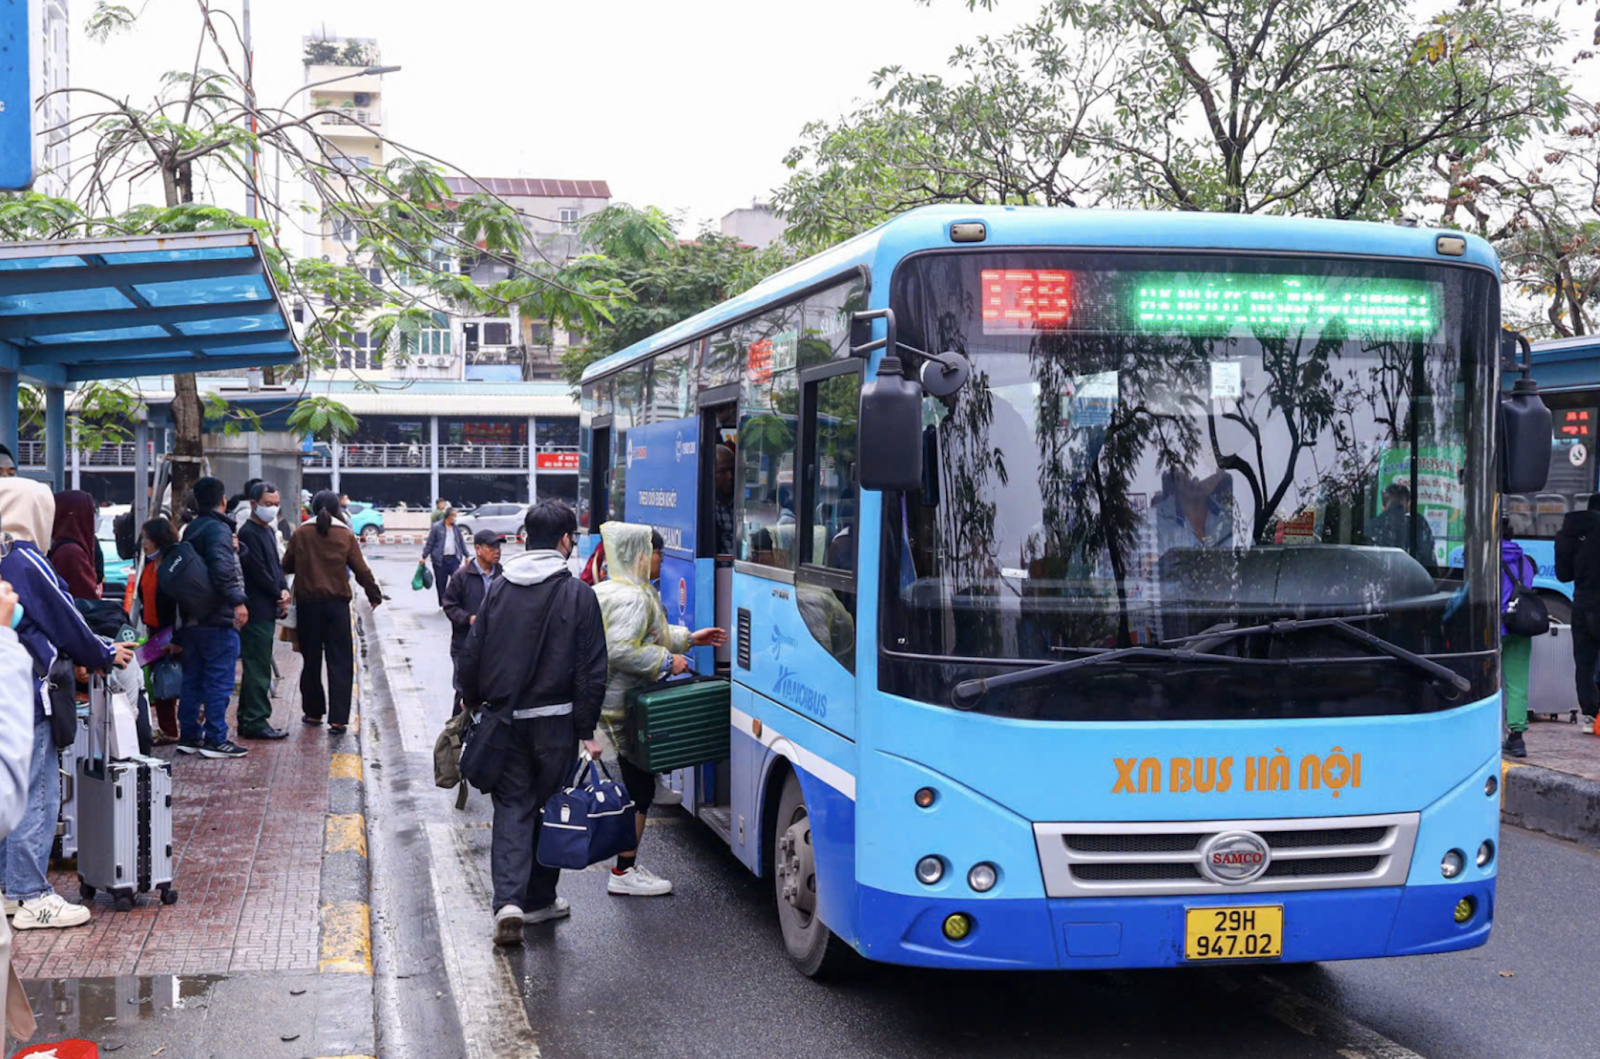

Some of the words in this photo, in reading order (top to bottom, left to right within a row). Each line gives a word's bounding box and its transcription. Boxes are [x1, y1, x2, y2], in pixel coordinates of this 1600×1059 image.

[1169, 756, 1233, 793] BUS
[1245, 747, 1290, 792] HÀ
[1299, 745, 1362, 798] NỘI
[1212, 852, 1263, 865] SAMCO
[1214, 910, 1255, 932] 29H
[1197, 933, 1272, 956] 947.02
